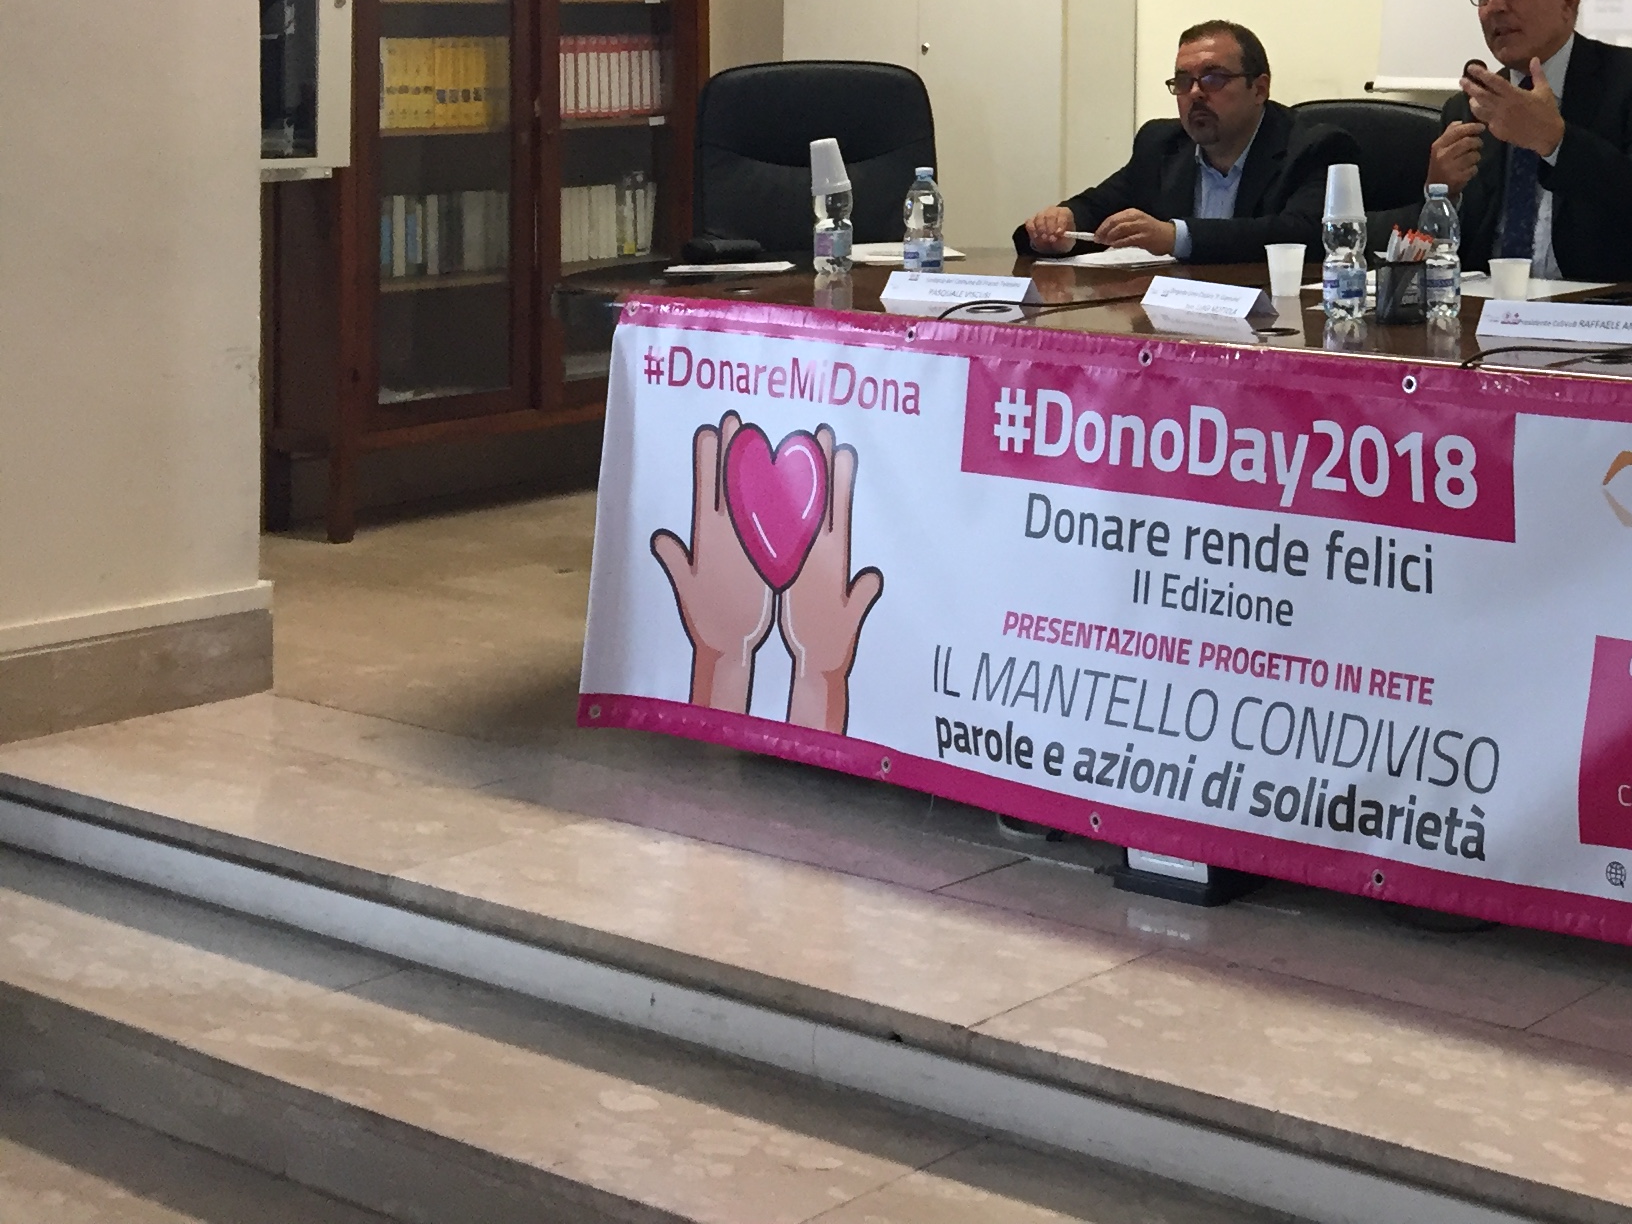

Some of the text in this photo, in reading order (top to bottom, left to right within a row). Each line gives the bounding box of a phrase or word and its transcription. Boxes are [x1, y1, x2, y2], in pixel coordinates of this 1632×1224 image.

[643, 345, 921, 416] #DonareMiDona
[994, 386, 1478, 510] #DonoDay2018
[1025, 493, 1434, 594] Donare rende felici
[1133, 571, 1295, 627] II Edizione
[1002, 611, 1434, 706] PRESENTAZIONE PROGETTO IN RETE
[932, 644, 1500, 795] IL MANTELLO CONDIVISO
[935, 714, 1486, 861] parole e azioni di solidarietà
